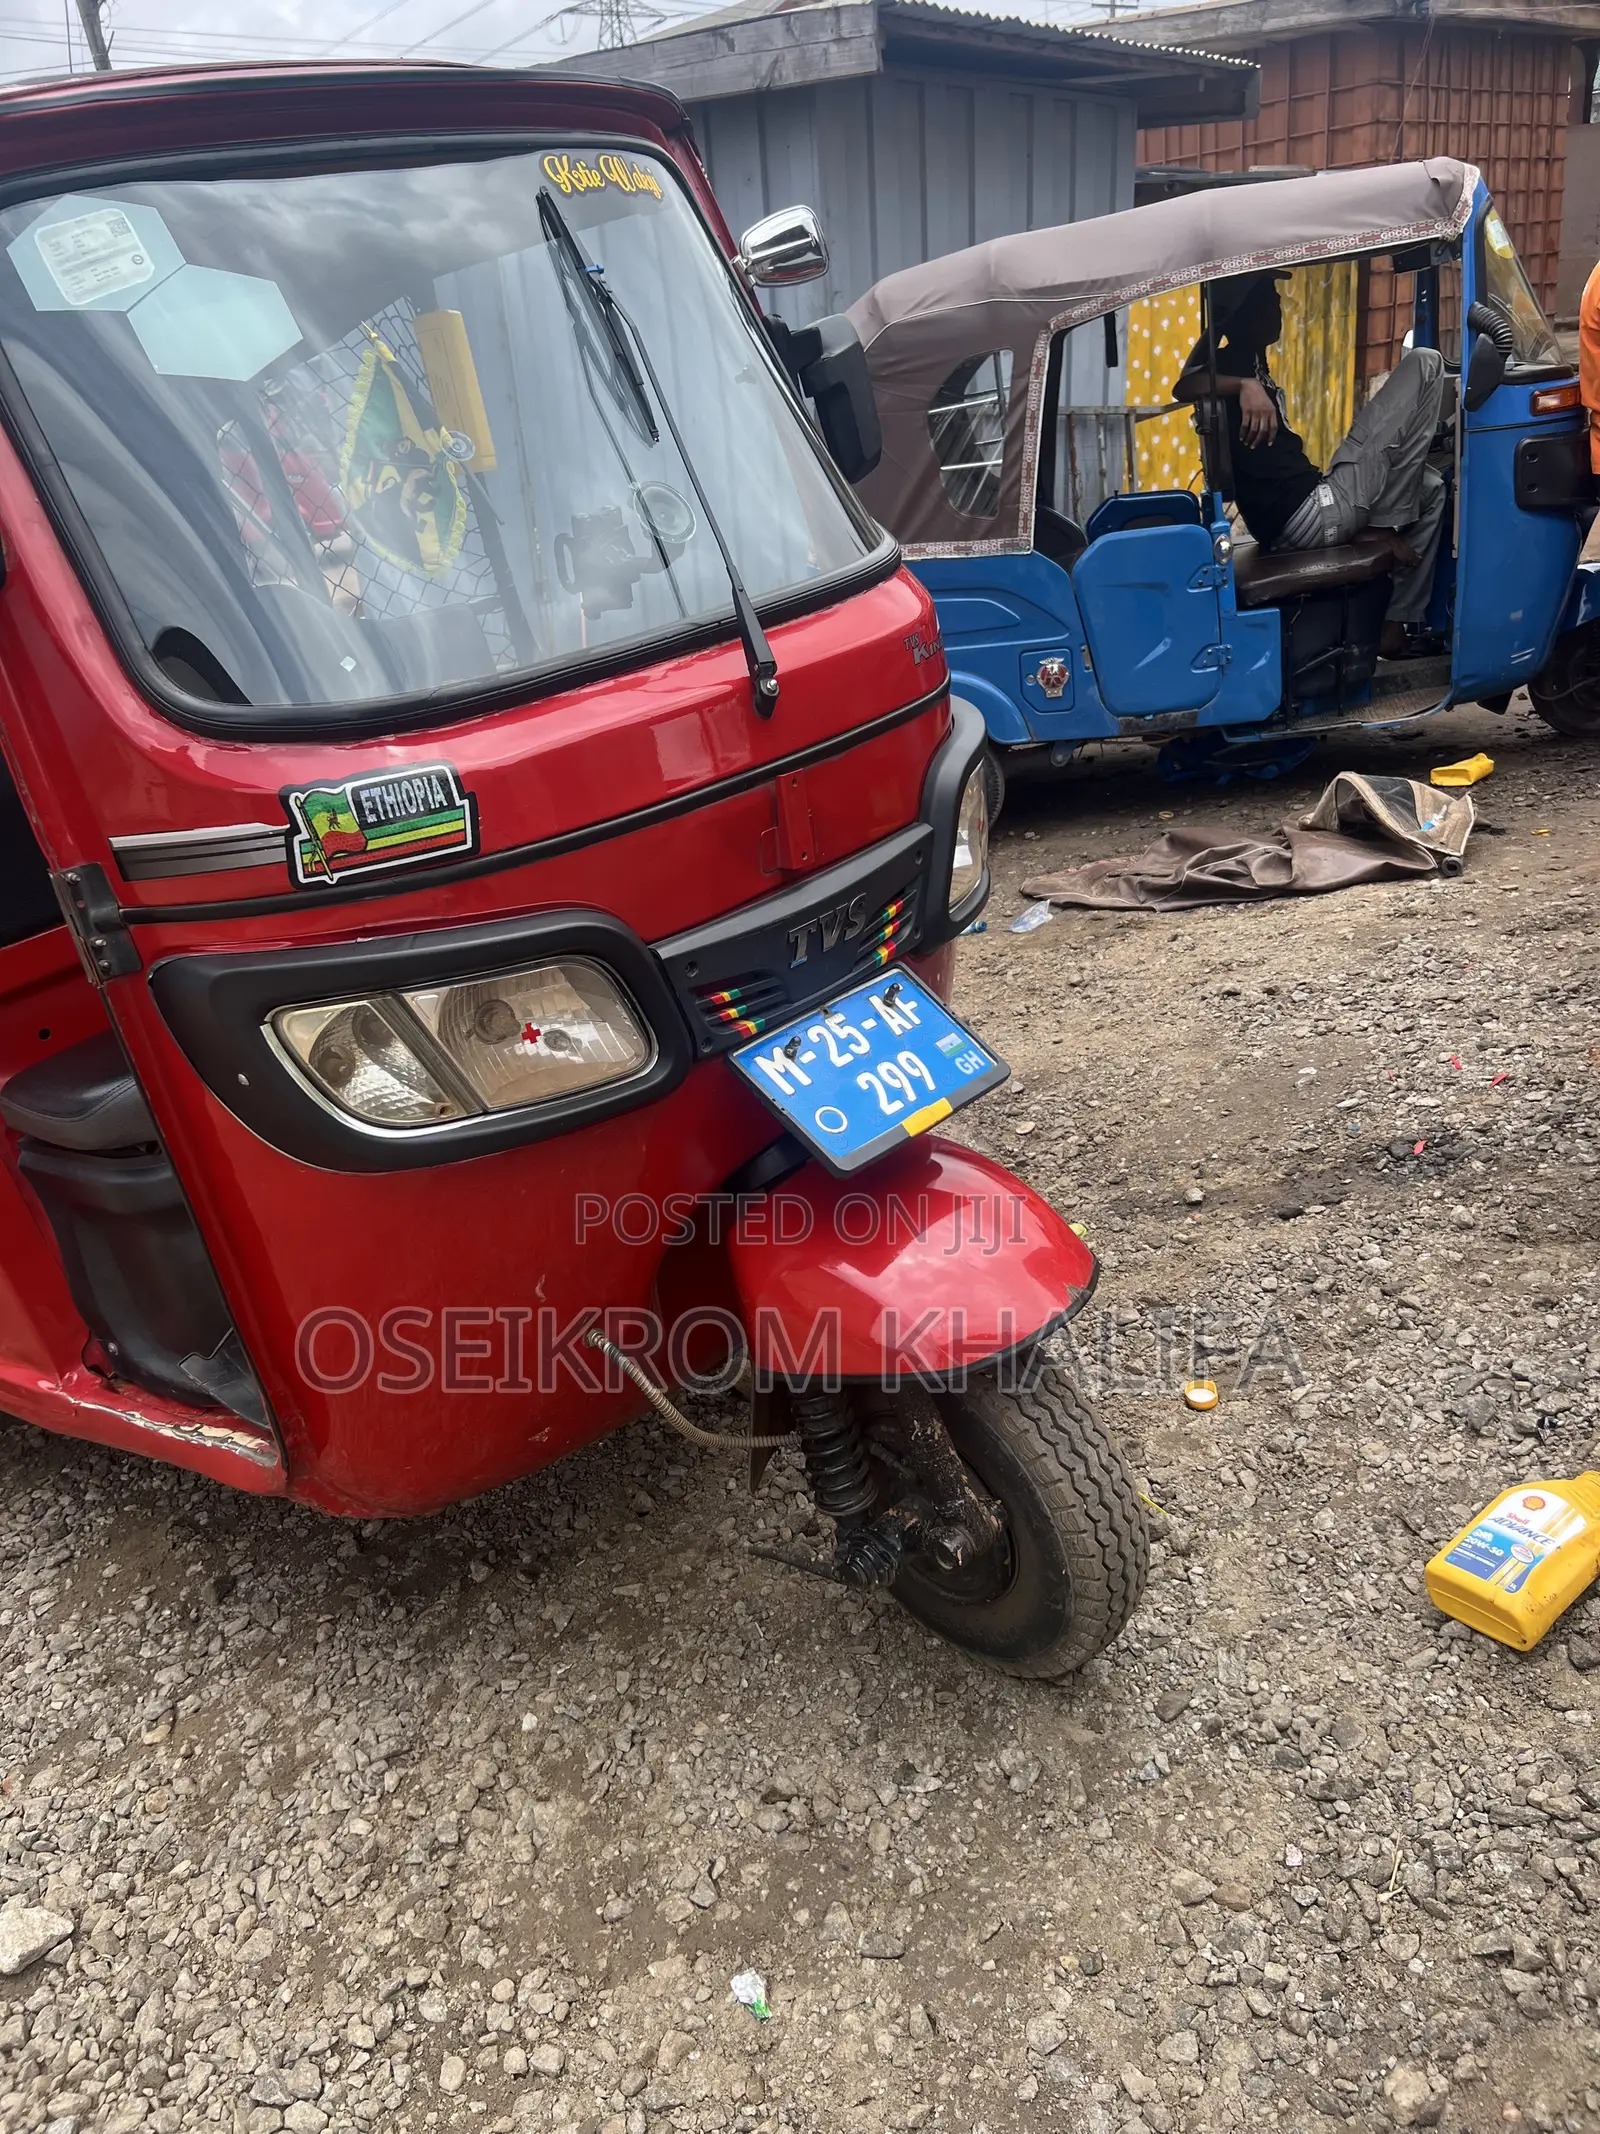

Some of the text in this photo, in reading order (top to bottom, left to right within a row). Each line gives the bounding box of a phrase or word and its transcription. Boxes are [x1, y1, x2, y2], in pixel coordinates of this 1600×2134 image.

[360, 775, 448, 823] ETHIOPIA
[788, 892, 867, 969] TVS
[955, 1050, 986, 1075] GH
[857, 1050, 936, 1115] 299
[1488, 1517, 1556, 1546] ADVANCE
[1506, 1512, 1530, 1525] Shell
